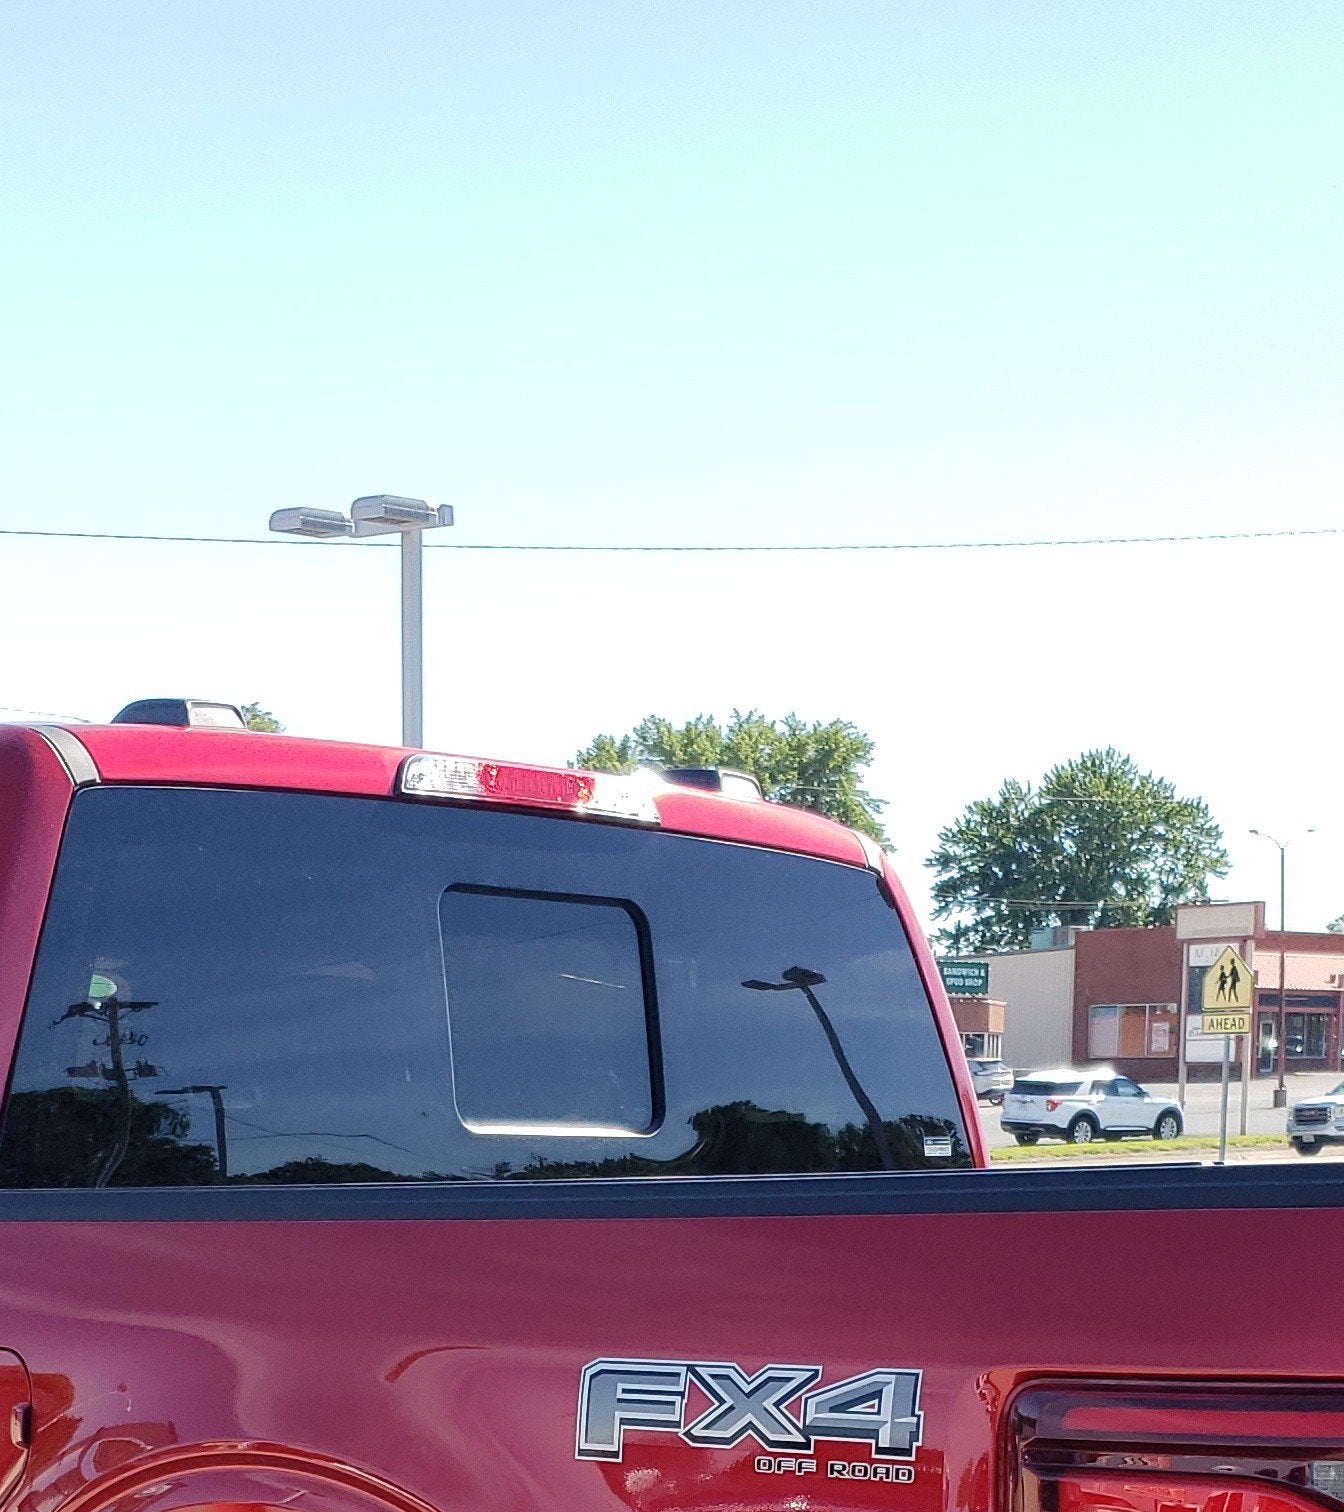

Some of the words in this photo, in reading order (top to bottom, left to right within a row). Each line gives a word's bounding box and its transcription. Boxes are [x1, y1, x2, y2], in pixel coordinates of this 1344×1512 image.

[1208, 1017, 1245, 1031] AHEAD
[575, 1357, 925, 1463] FX4
[754, 1456, 818, 1476] OFF
[827, 1460, 916, 1484] ROAD
